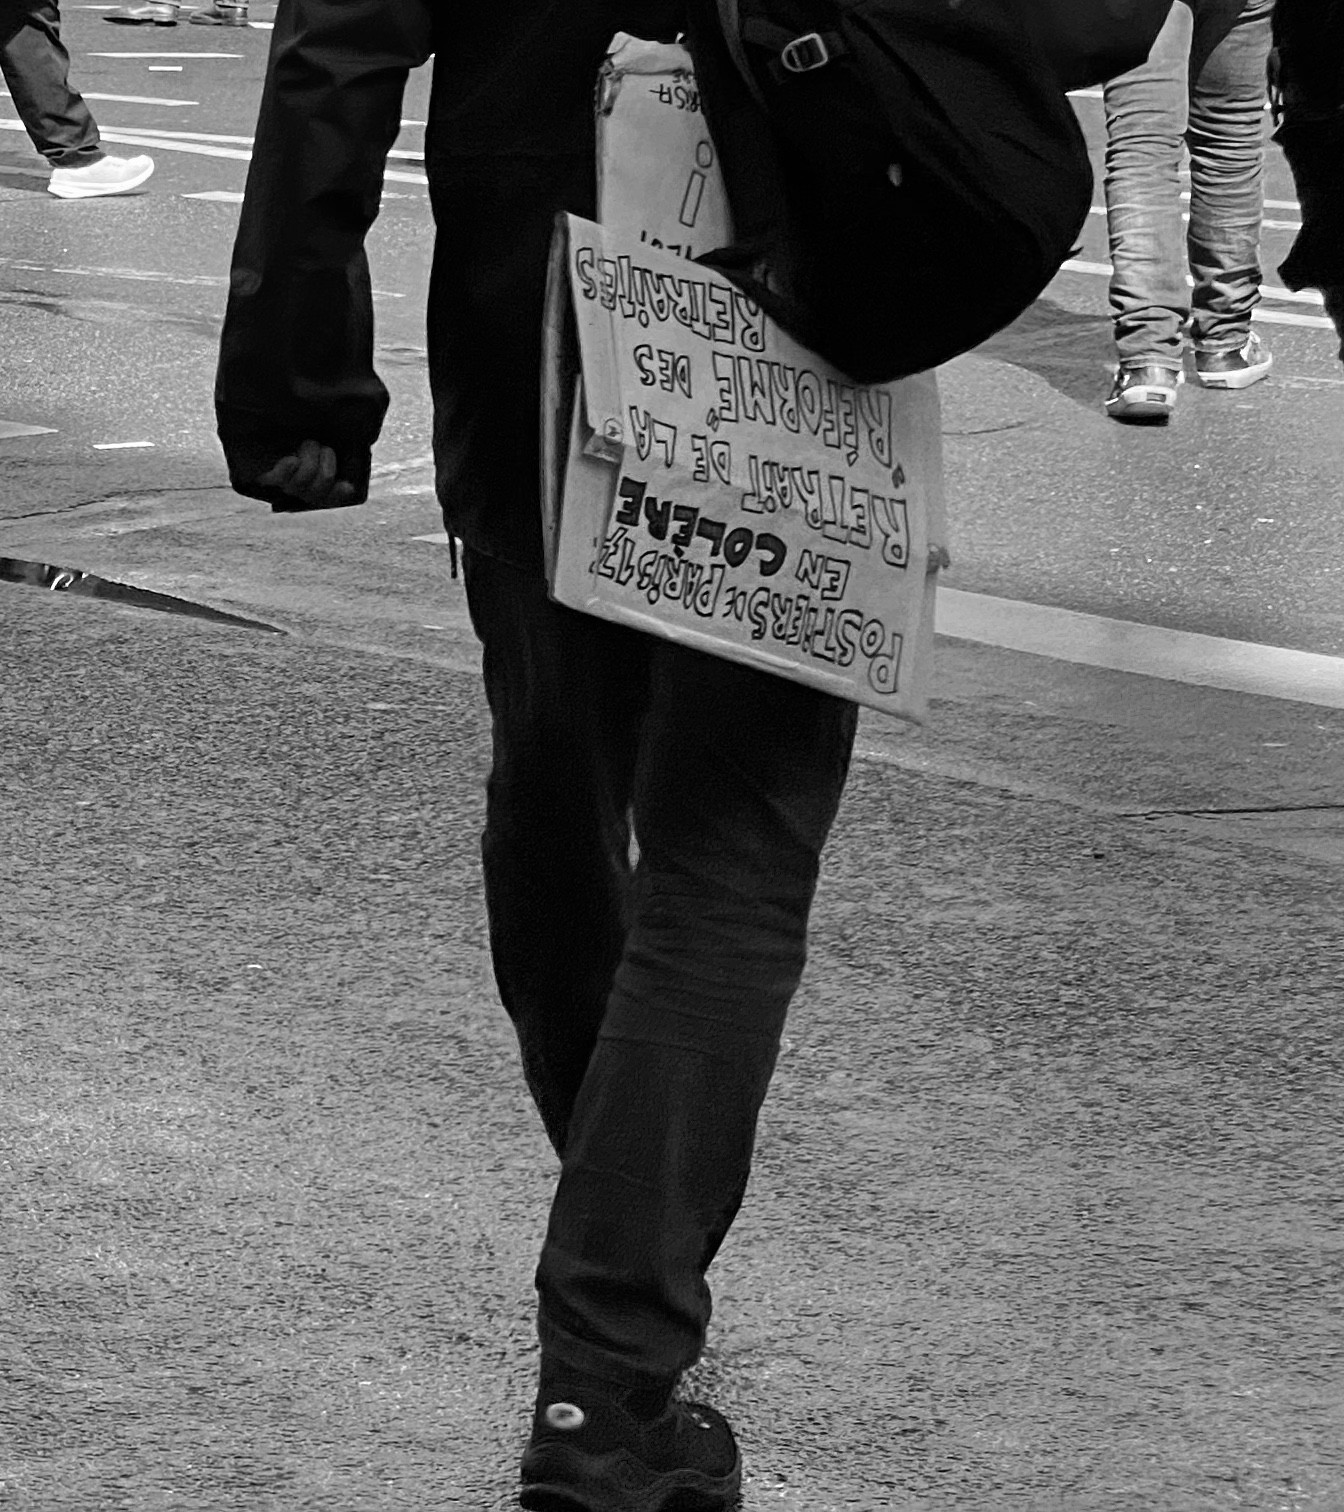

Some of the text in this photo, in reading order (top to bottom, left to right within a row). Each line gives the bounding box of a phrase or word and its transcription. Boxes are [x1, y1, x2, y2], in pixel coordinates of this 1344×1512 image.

[633, 343, 693, 399] DES
[629, 404, 678, 469] LA
[691, 433, 732, 485] DE
[616, 475, 851, 601] EN COLÈRE
[723, 586, 748, 622] DE
